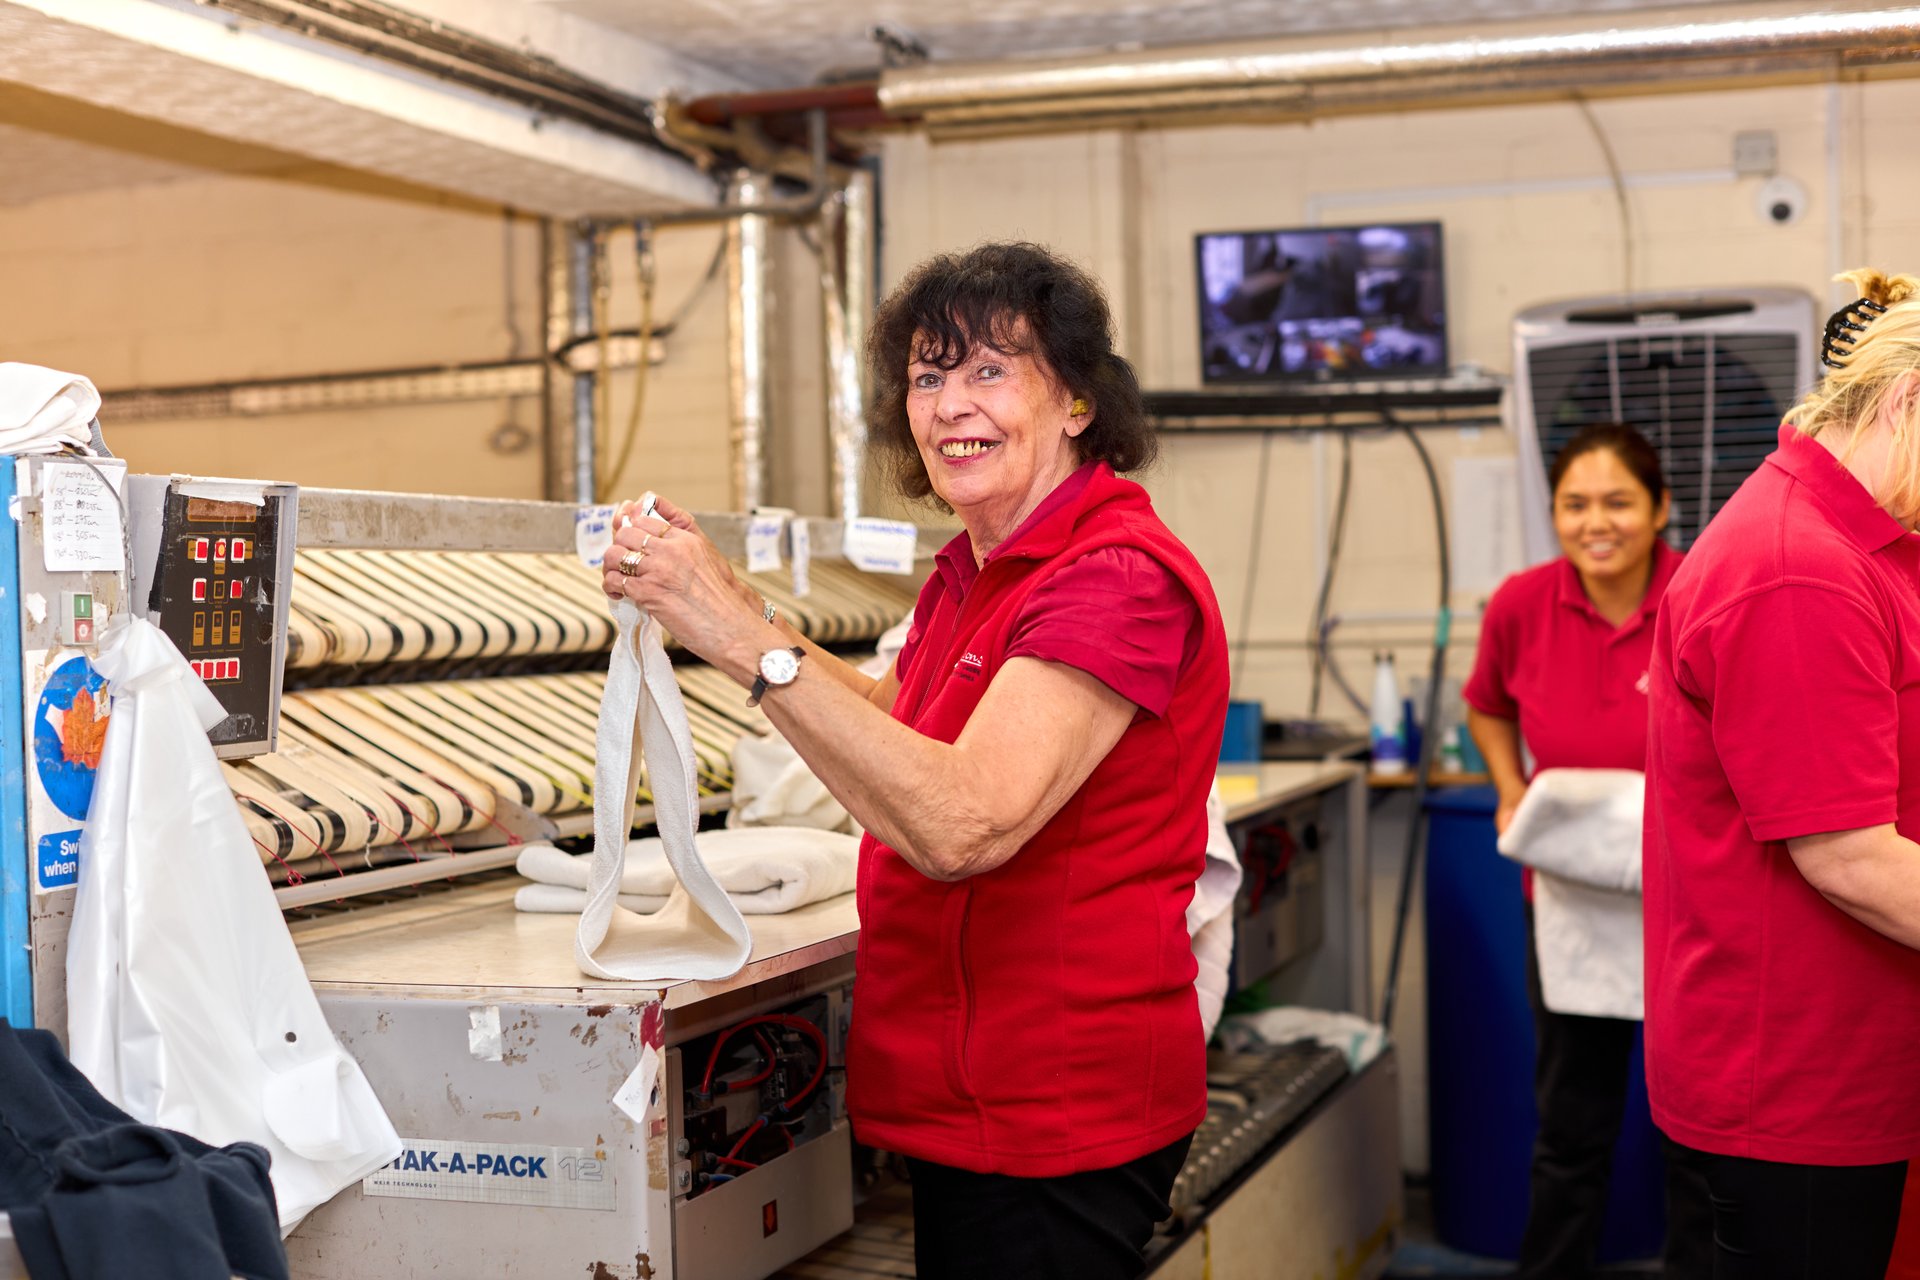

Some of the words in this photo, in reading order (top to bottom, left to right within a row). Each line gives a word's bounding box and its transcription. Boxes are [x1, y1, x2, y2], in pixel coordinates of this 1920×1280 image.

[44, 860, 77, 877] when
[380, 1150, 548, 1179] TAK-A-PACK
[558, 1156, 603, 1182] 12
[393, 1180, 437, 1188] TECHNOLOGY
